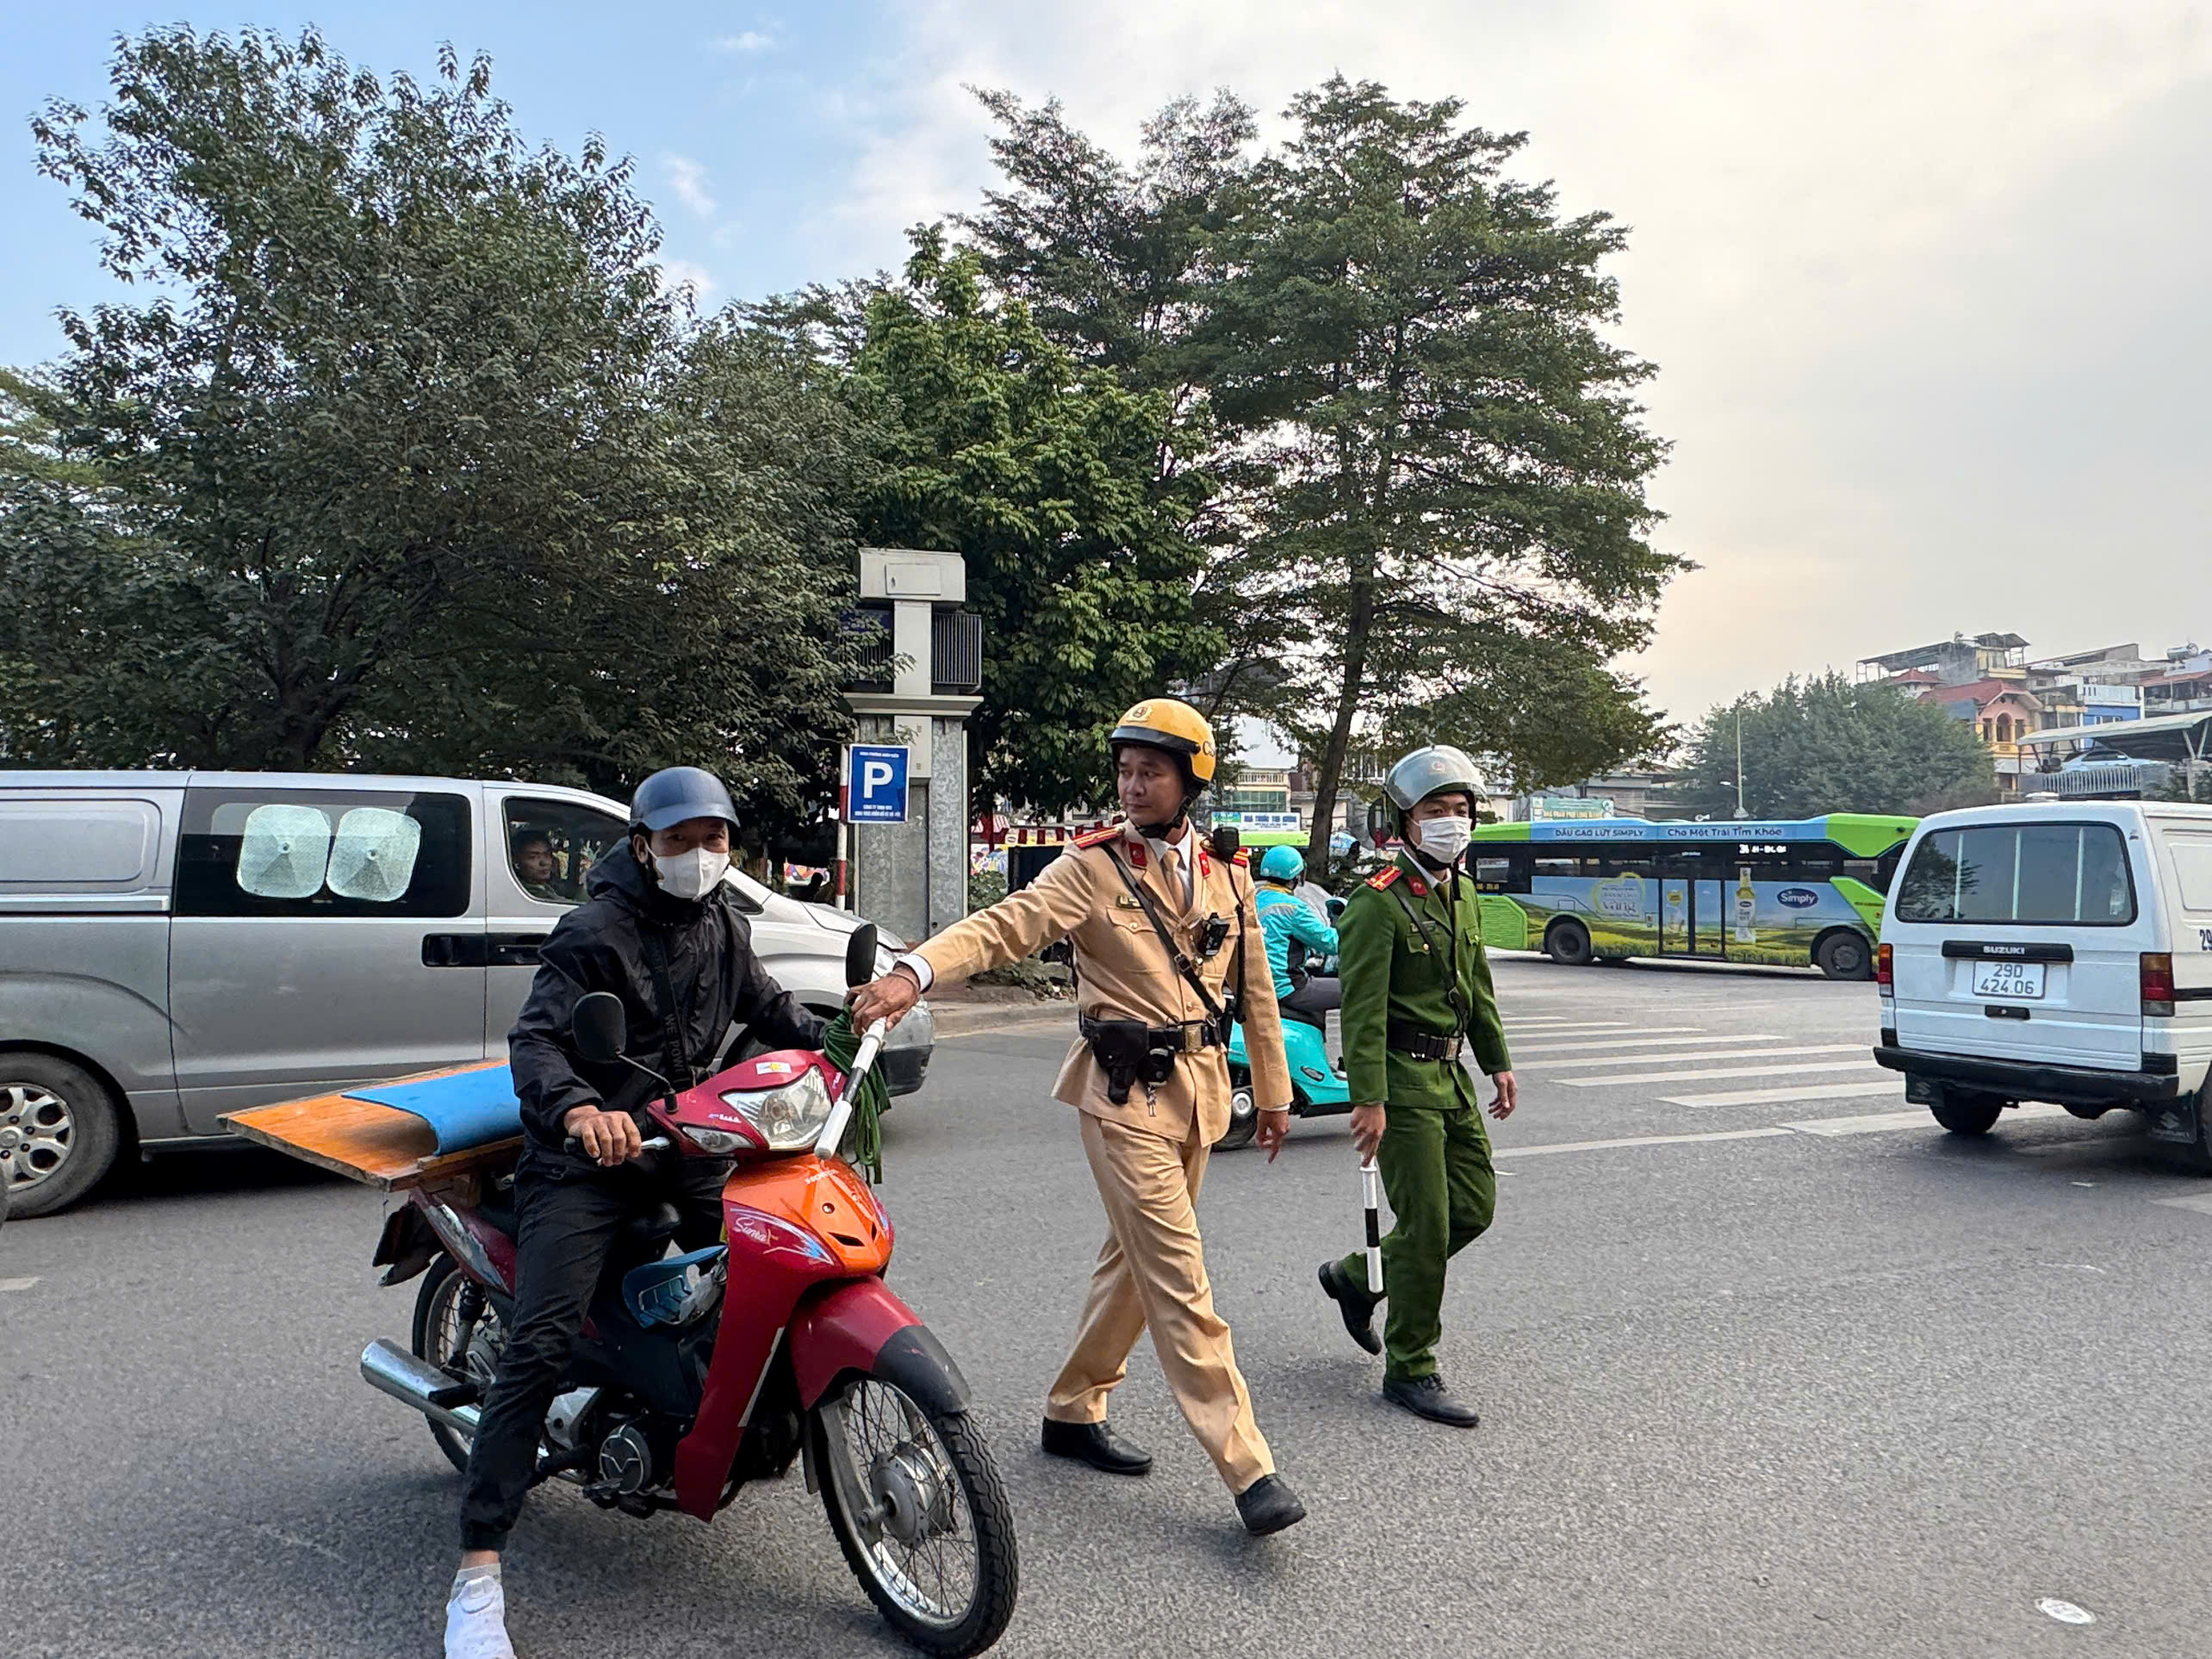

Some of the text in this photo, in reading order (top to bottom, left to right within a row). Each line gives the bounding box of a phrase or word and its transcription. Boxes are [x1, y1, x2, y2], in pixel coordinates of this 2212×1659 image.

[863, 761, 894, 798] P
[1668, 828, 1687, 836] Cho
[1780, 891, 1815, 904] Simply
[1983, 946, 2025, 954] SUZUKI
[1993, 964, 2023, 979] 29D
[1980, 978, 2035, 994] 424.06
[664, 1013, 677, 1034] WE
